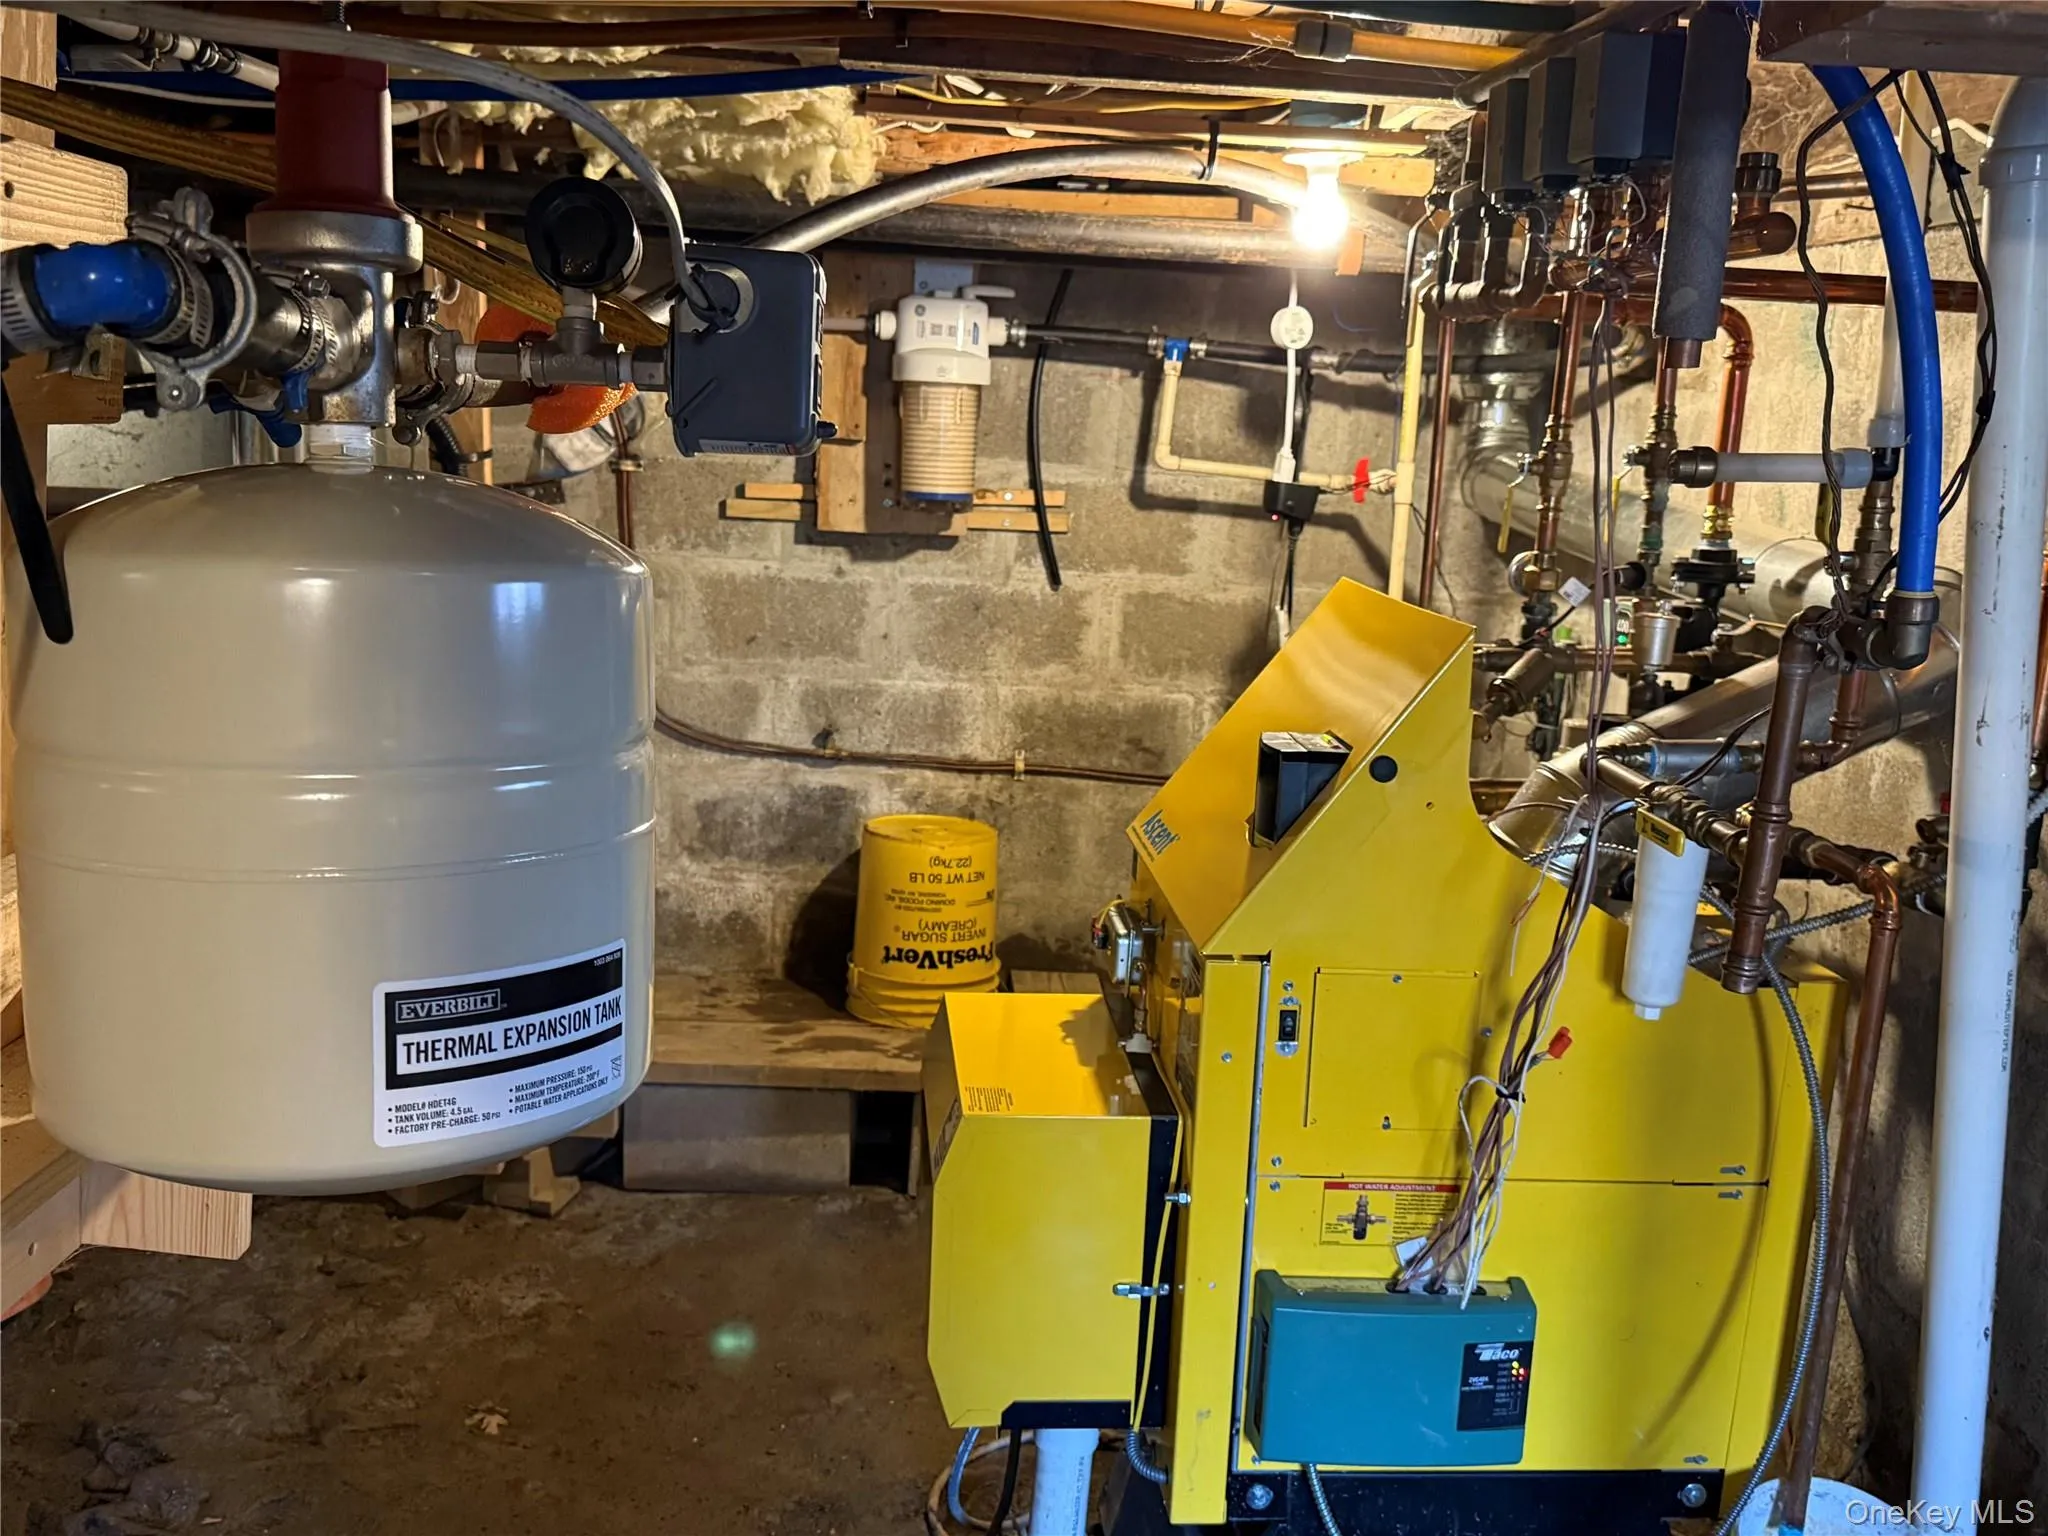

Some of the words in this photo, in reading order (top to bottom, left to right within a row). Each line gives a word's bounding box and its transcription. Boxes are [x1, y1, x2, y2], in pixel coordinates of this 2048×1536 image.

[1140, 809, 1179, 855] Ascent
[929, 856, 972, 869] (22.7kg)
[909, 872, 925, 883] LB
[928, 872, 942, 884] 50
[945, 872, 964, 884] WT
[966, 871, 985, 883] NET
[918, 917, 977, 931] (CREAMY)
[902, 930, 947, 943] SUGAR
[400, 993, 496, 1019] EVERBILT
[402, 1031, 498, 1065] THERMAL
[503, 1007, 591, 1050] EXPANSION
[594, 995, 622, 1025] TANK
[514, 1079, 546, 1093] MAXIMUM
[546, 1069, 577, 1085] PRESSURE:
[577, 1065, 587, 1075] 150
[514, 1089, 546, 1103] MAXIMUM
[546, 1077, 586, 1095] TEMPERATURE:
[514, 1101, 542, 1114] POTABLE
[543, 1095, 562, 1106] WATER
[562, 1081, 598, 1100] APPLICATIONS
[598, 1076, 609, 1088] ONLY
[394, 1102, 426, 1113] MODEL#
[394, 1114, 414, 1124] TANK
[416, 1109, 449, 1122] VOLUME:
[450, 1106, 462, 1116] 4.5
[463, 1106, 474, 1114] GAL
[394, 1122, 429, 1135] FACTORY
[431, 1114, 481, 1130] PRE-CHARGE:
[482, 1112, 491, 1121] 50
[1474, 1343, 1520, 1361] Taco
